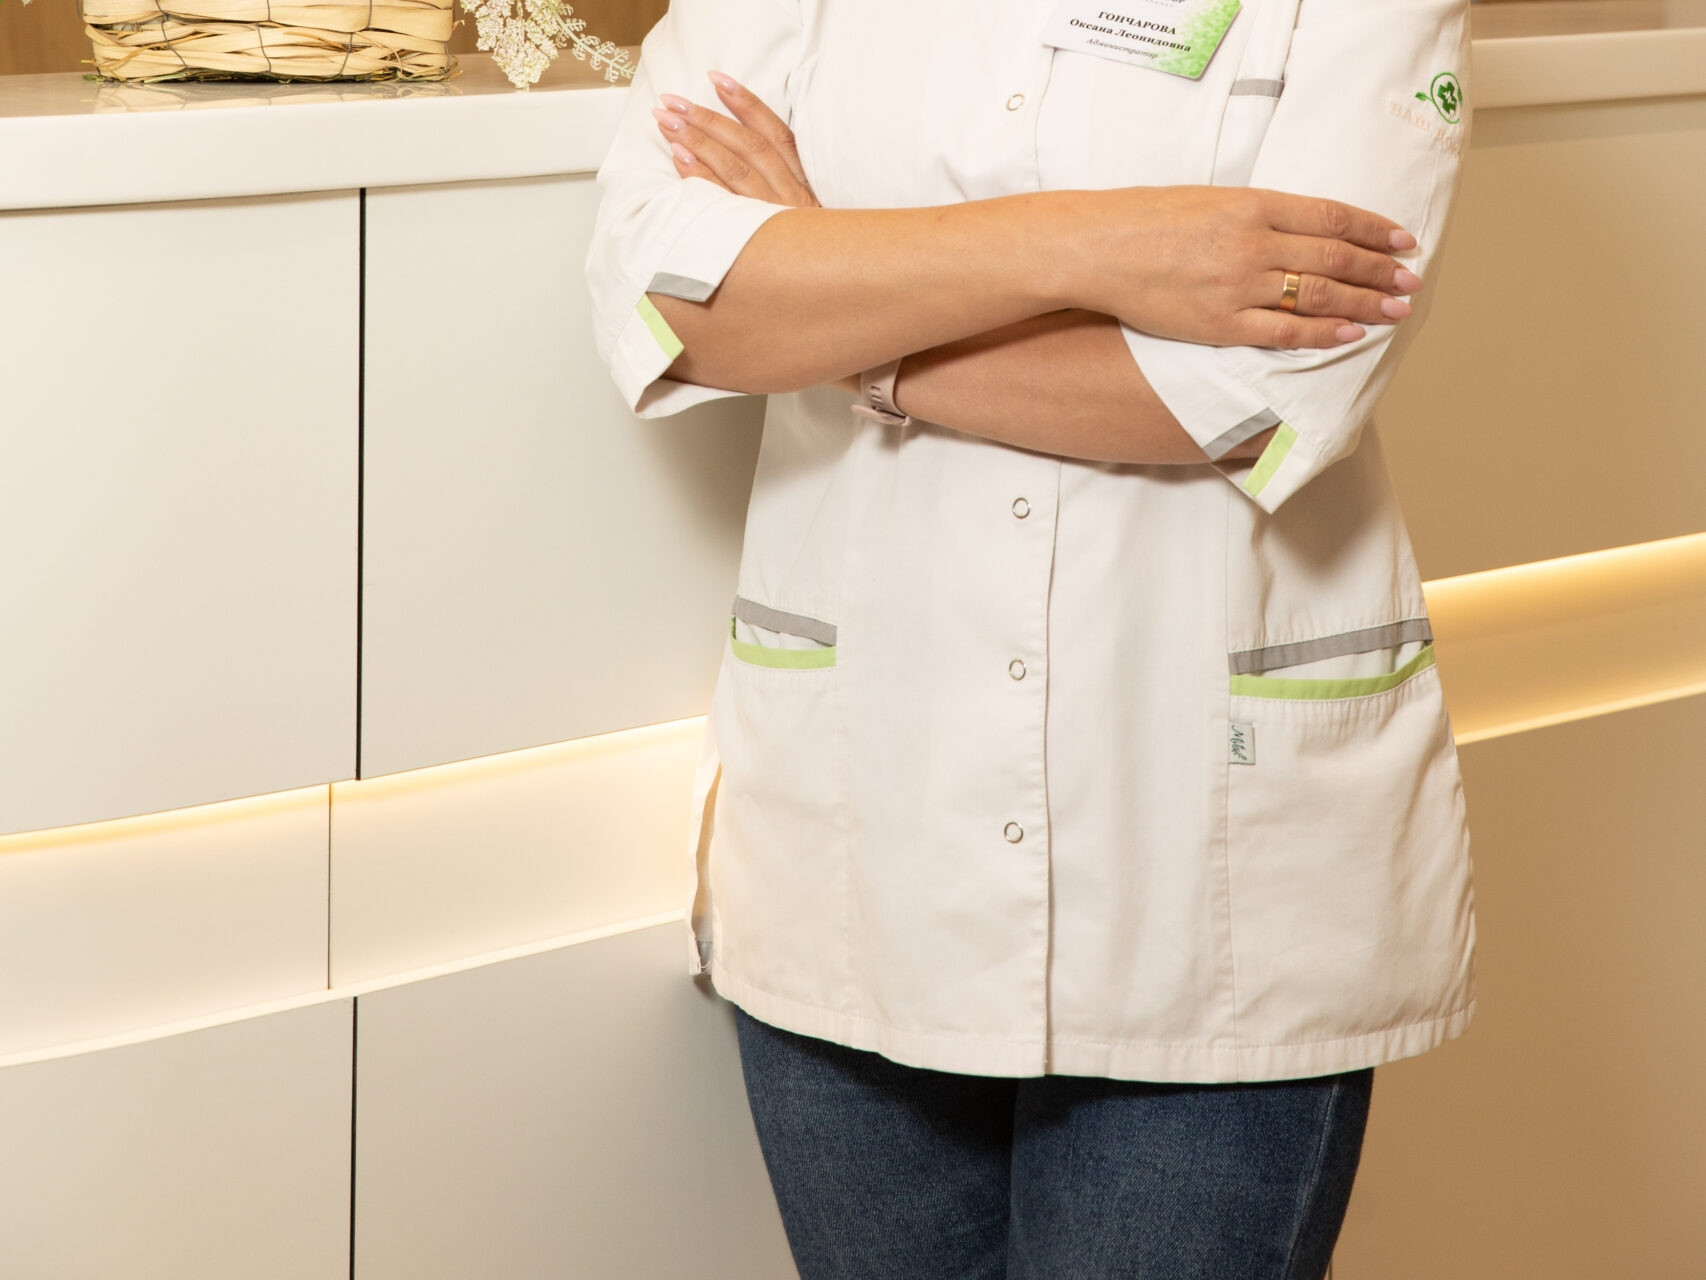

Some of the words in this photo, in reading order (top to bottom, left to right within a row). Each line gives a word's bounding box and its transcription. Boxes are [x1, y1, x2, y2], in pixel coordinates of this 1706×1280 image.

[1069, 18, 1113, 35] Оксана
[1115, 28, 1191, 52] Леонидовна
[1097, 11, 1177, 35] ГОНЧАРОВА
[1086, 38, 1158, 60] Администратор
